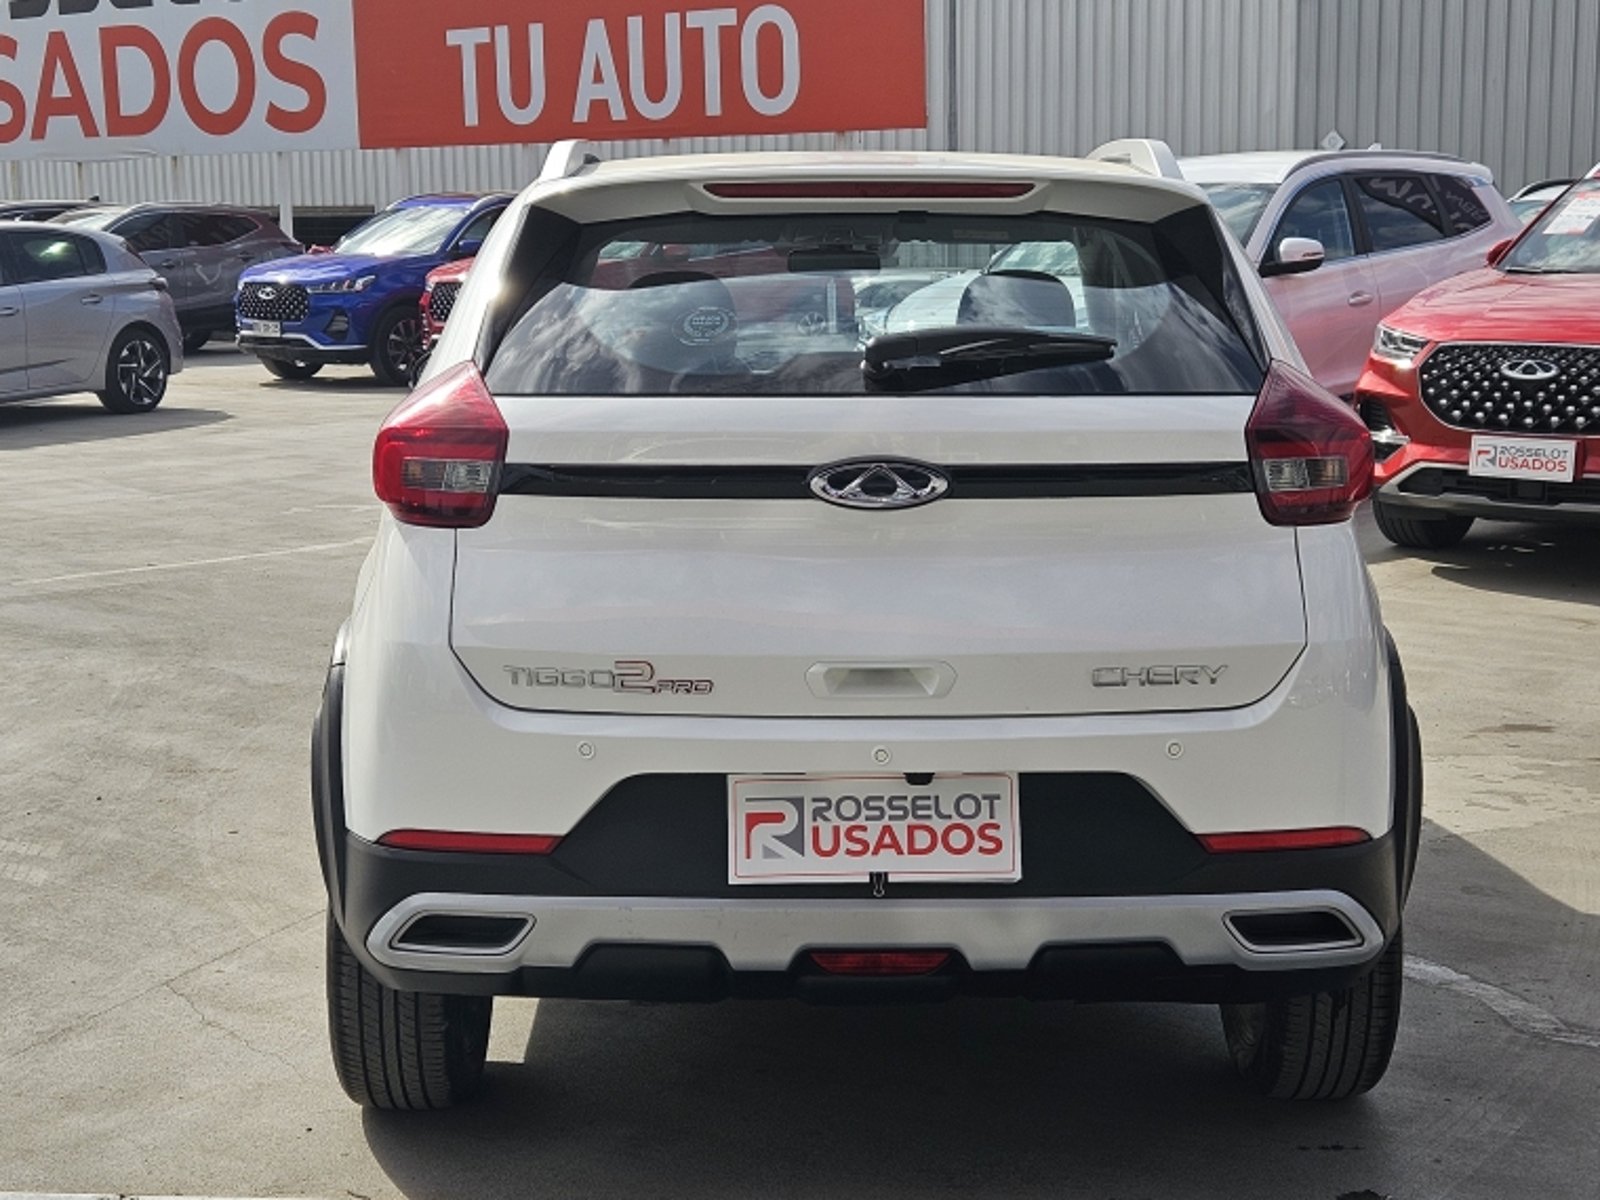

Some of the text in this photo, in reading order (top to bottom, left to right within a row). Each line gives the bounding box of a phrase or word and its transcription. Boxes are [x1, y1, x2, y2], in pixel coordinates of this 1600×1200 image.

[446, 4, 800, 126] TU AUTO
[1498, 457, 1567, 472] USADOS
[1499, 446, 1569, 459] ROSSELOT
[1092, 664, 1229, 687] CHERY
[811, 793, 1001, 822] ROSSELOT
[811, 823, 1003, 857] USADOS
